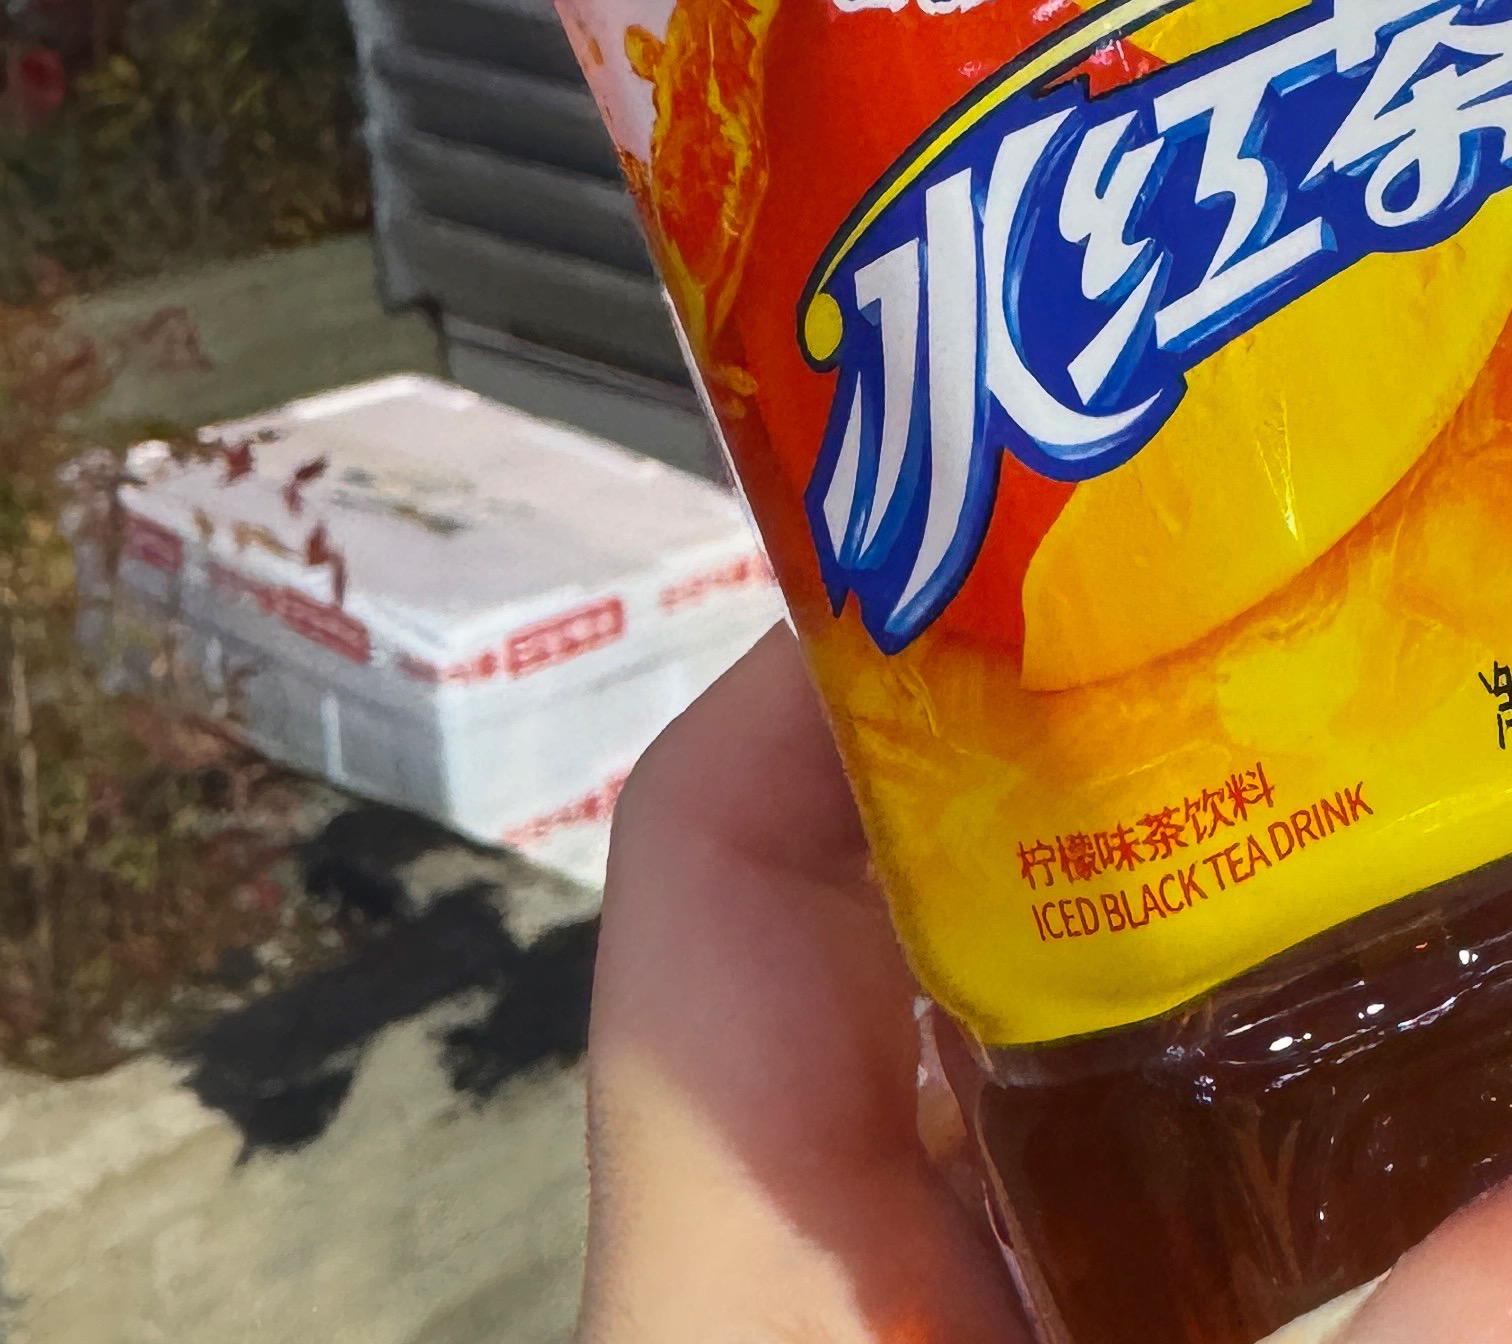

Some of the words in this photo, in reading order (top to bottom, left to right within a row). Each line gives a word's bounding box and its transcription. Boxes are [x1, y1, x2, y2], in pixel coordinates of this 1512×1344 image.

[1016, 760, 1276, 891] 柠檬味茶饮料
[1031, 896, 1101, 942] ICED
[1100, 859, 1209, 933] BLACK
[1202, 833, 1273, 892] TEA
[1267, 781, 1375, 861] DRINK
